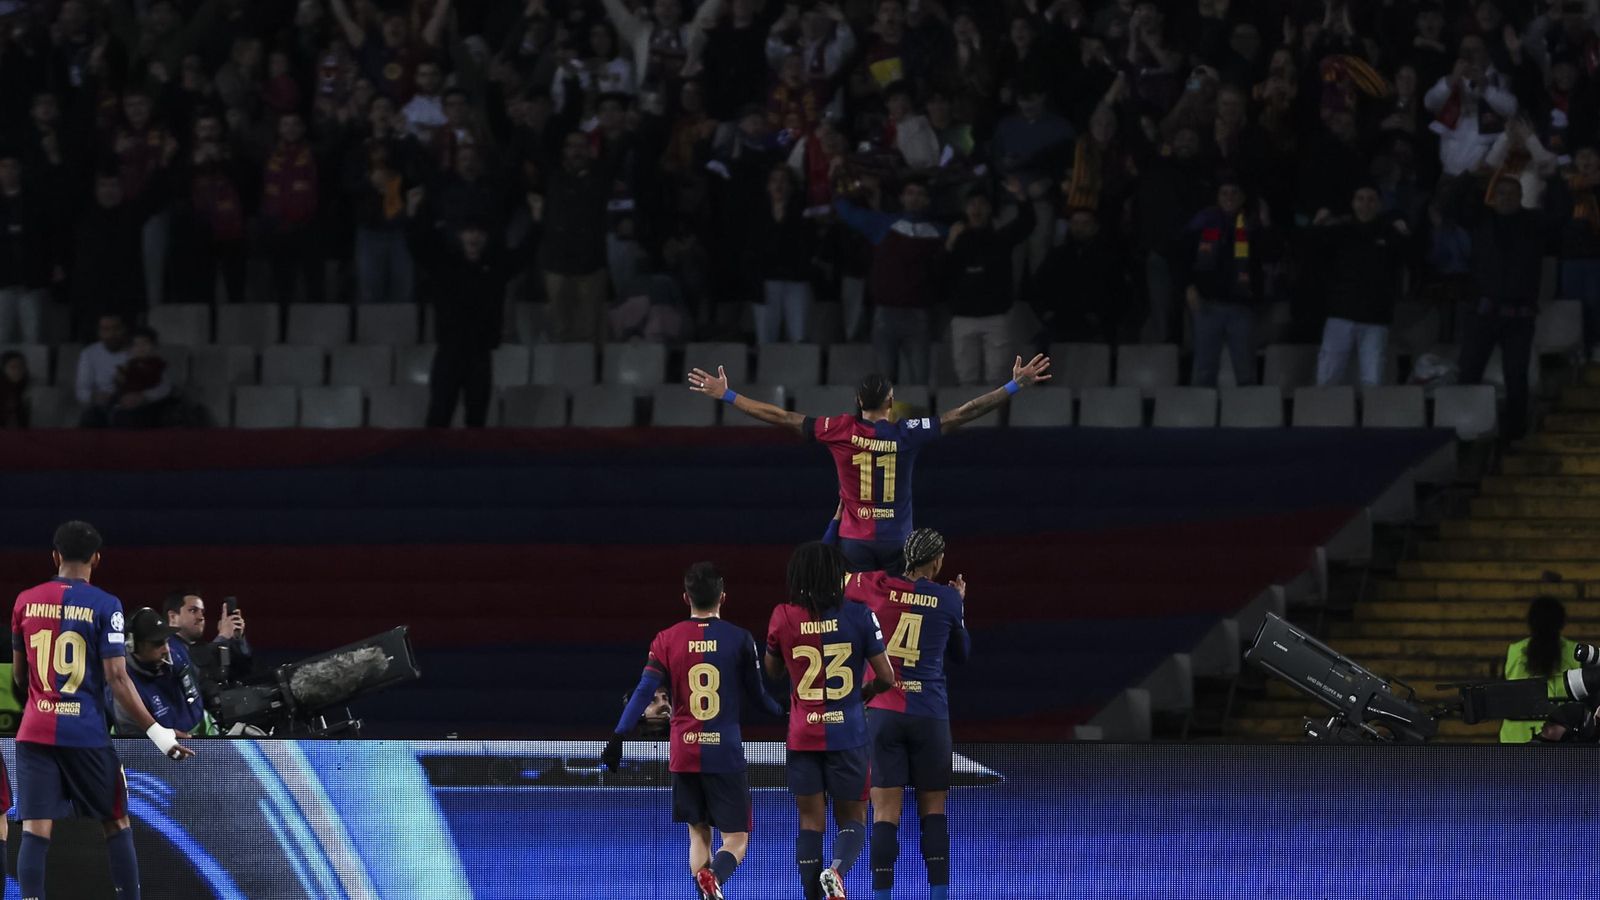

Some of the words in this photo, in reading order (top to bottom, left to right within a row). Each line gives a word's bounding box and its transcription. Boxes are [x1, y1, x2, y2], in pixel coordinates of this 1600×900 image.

[851, 434, 897, 452] RAPHINHA
[852, 451, 897, 503] 11
[25, 603, 62, 619] LAMINE
[64, 605, 94, 623] YAMAL
[889, 590, 898, 603] R.
[900, 592, 938, 608] ARAUJO
[800, 619, 838, 635] KOUNDE
[886, 611, 924, 668] 4
[30, 629, 87, 694] 19
[688, 639, 717, 653] PEDRI
[791, 642, 854, 701] 23
[687, 662, 720, 721] 8
